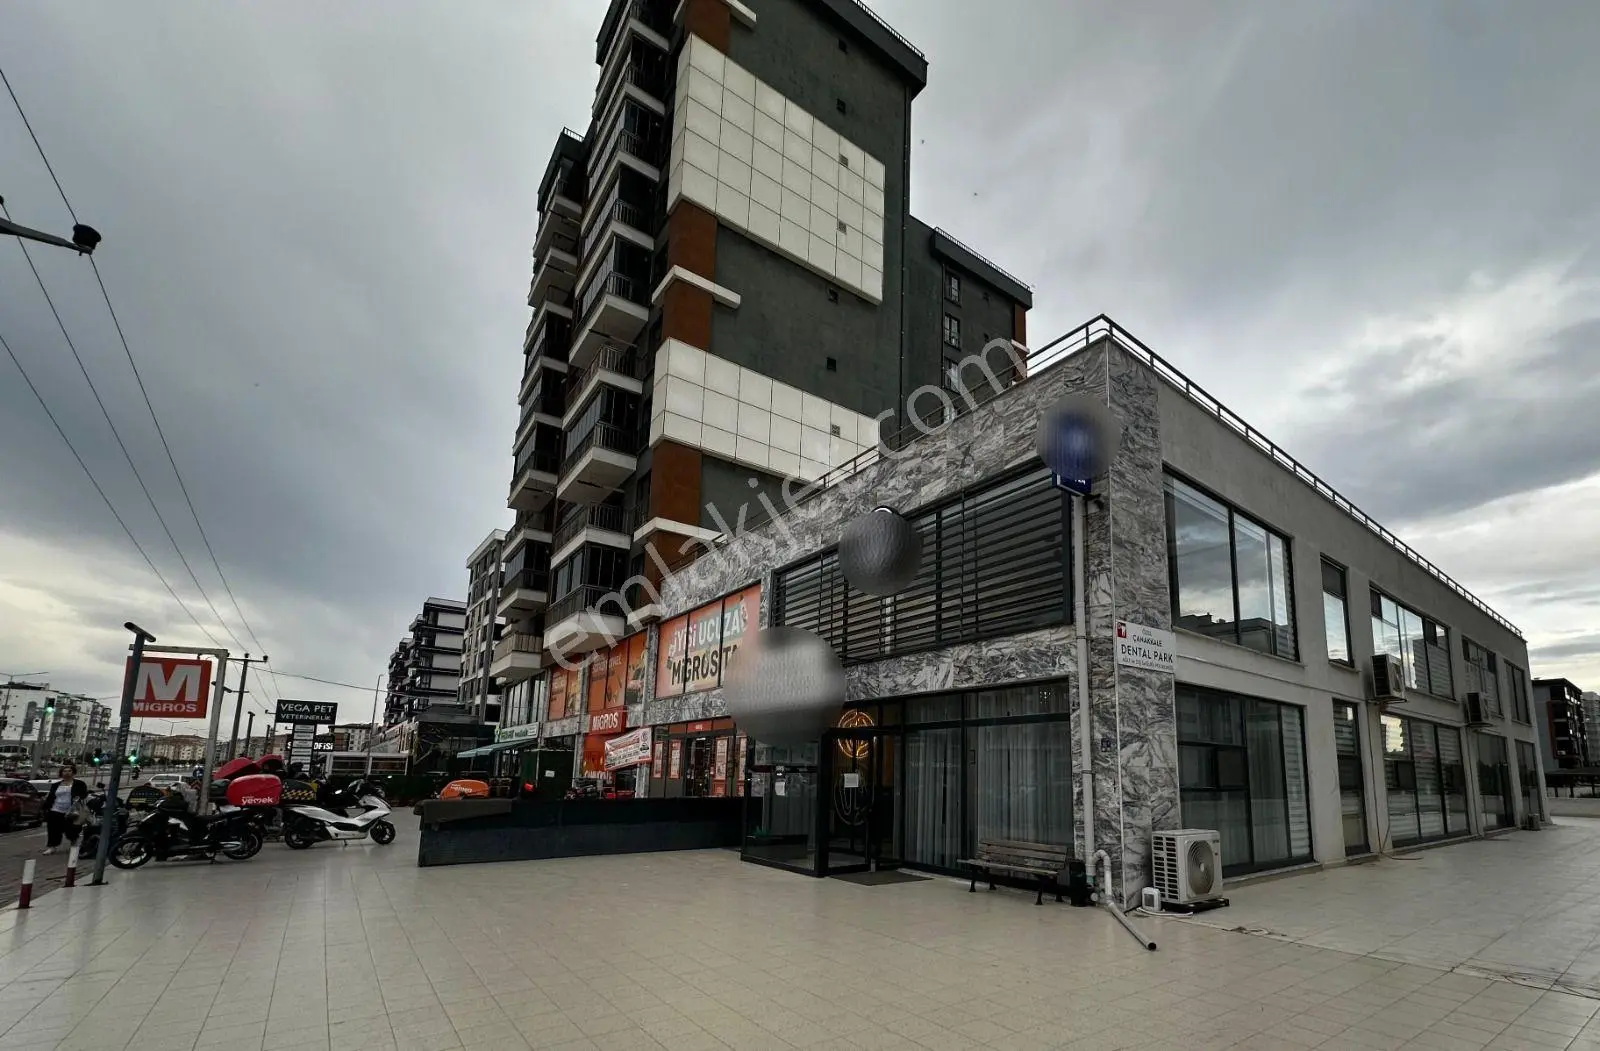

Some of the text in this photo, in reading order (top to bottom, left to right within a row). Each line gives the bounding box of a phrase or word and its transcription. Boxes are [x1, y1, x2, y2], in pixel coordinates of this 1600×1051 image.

[1121, 644, 1152, 660] DENTAL
[1153, 650, 1173, 664] PARK
[280, 703, 334, 713] VEGA PET
